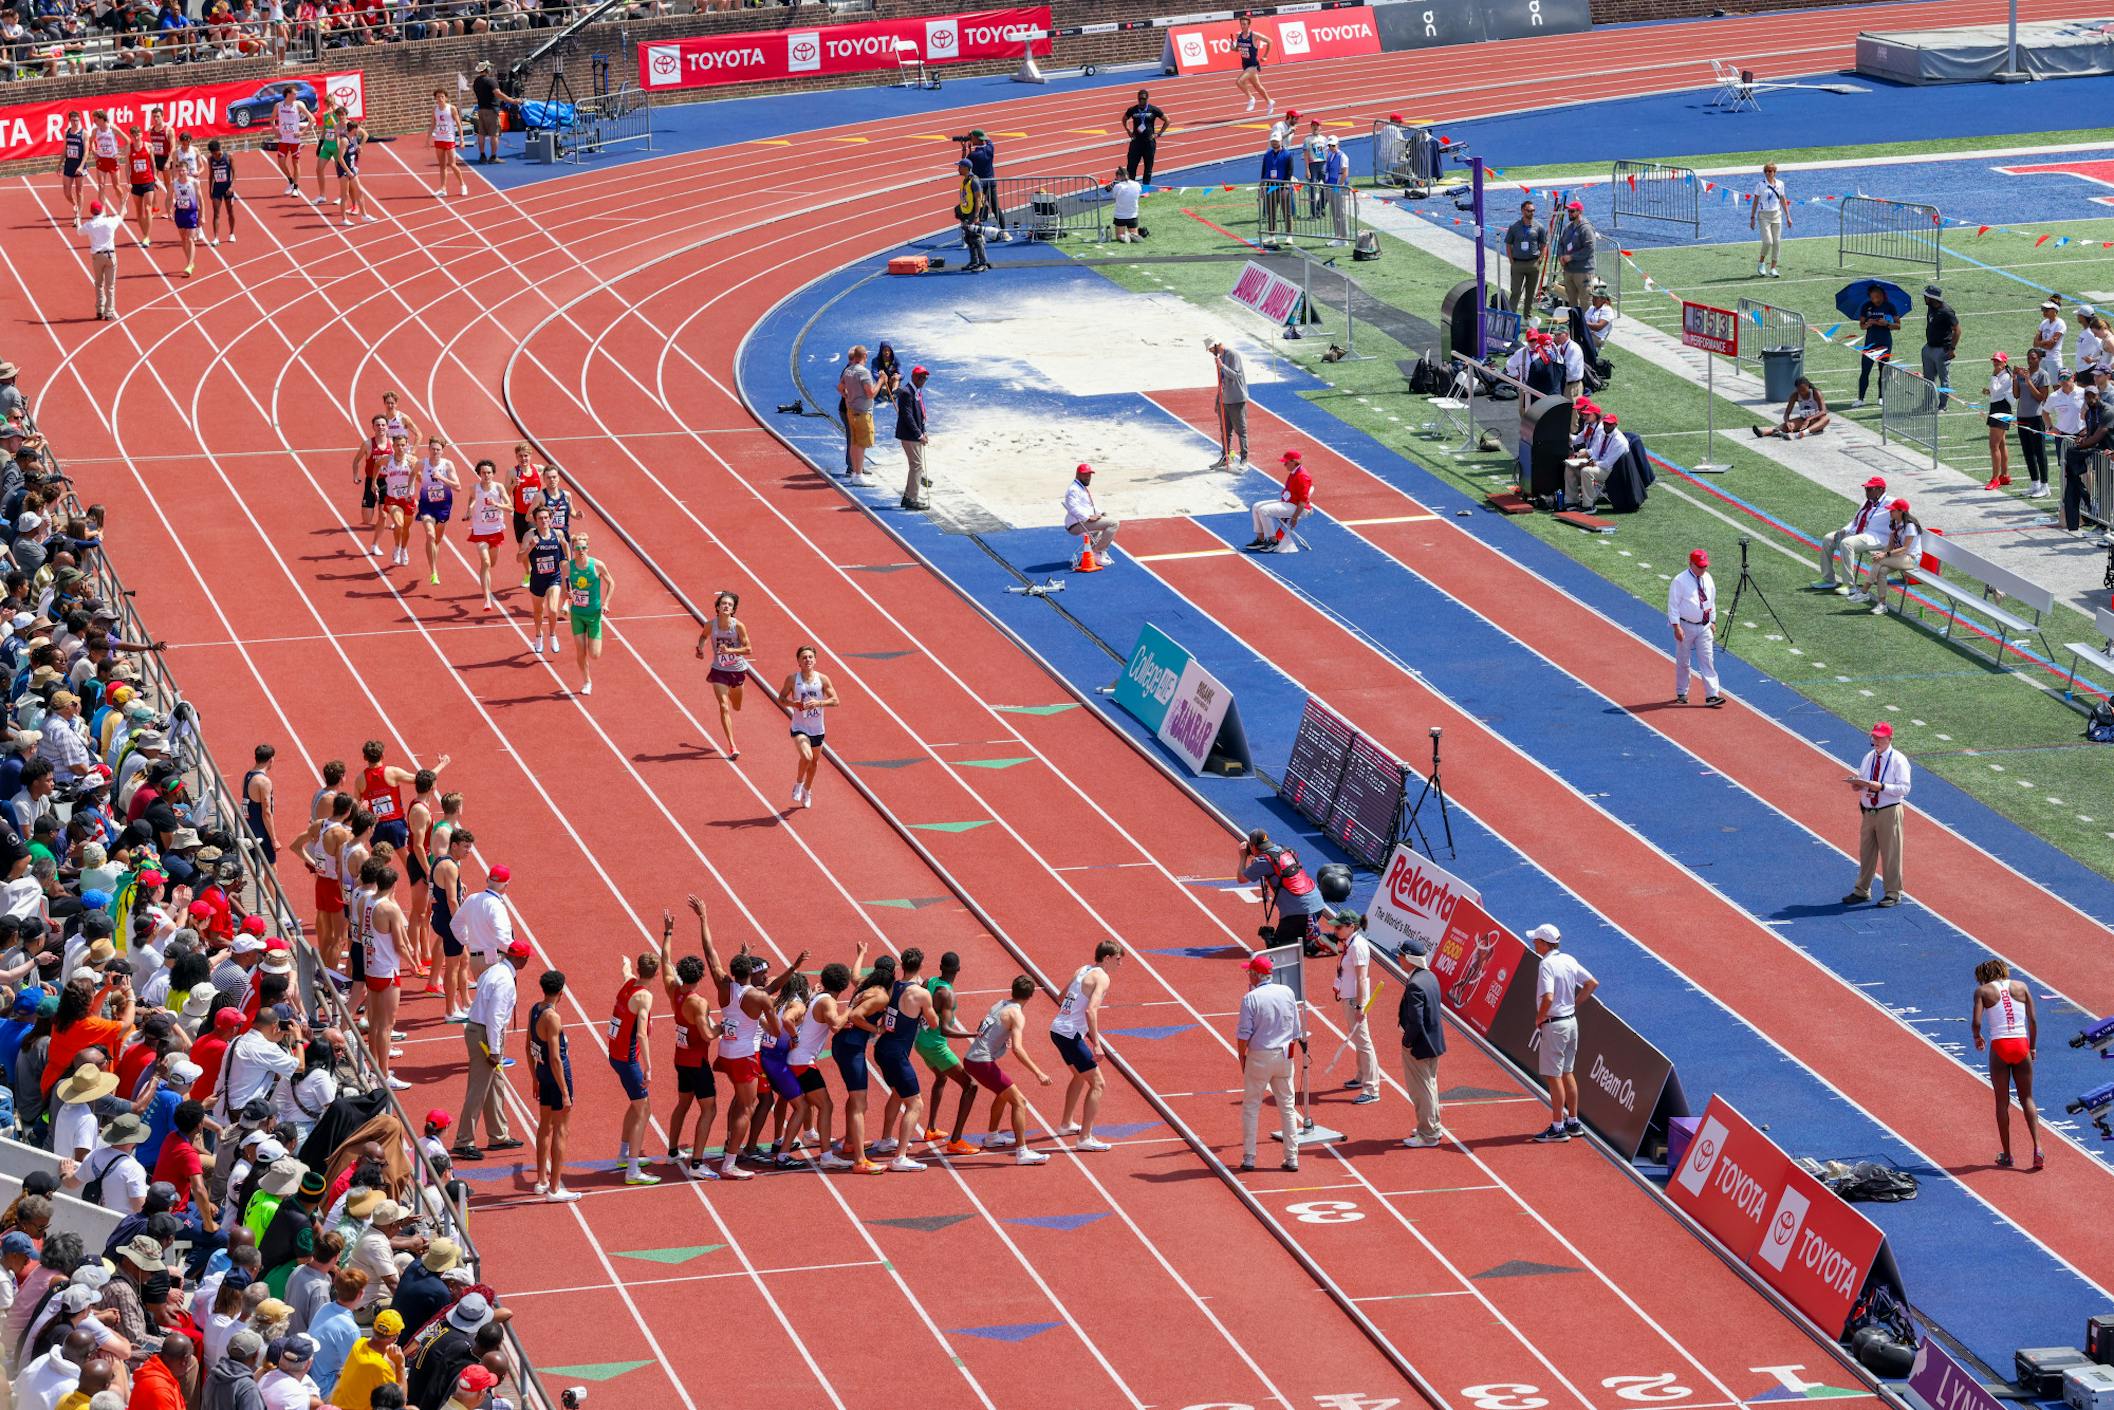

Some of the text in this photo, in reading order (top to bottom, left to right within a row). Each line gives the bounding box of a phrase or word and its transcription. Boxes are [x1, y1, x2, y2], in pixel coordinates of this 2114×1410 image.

[826, 35, 900, 57] TOYOTA
[1311, 23, 1373, 43] TOYOTA
[687, 48, 766, 71] TOYOTA
[1129, 645, 1162, 698] College
[1386, 854, 1460, 922] Rekorta
[1374, 905, 1386, 921] The
[1385, 911, 1405, 933] World's
[1402, 923, 1417, 940] Most
[1443, 938, 1464, 961] GOOD
[1435, 952, 1458, 976] MOVE
[2001, 989, 2015, 1033] CORNELL
[1589, 1054, 1637, 1112] Dream On.
[1715, 1155, 1768, 1224] TOYOTA
[1284, 1200, 1366, 1224] 3
[1798, 1228, 1858, 1300] TOYOTA
[1601, 1373, 1693, 1401] 2
[1748, 1364, 1825, 1392] 1
[1936, 1365, 1992, 1410] LYN
[1460, 1383, 1550, 1410] 3
